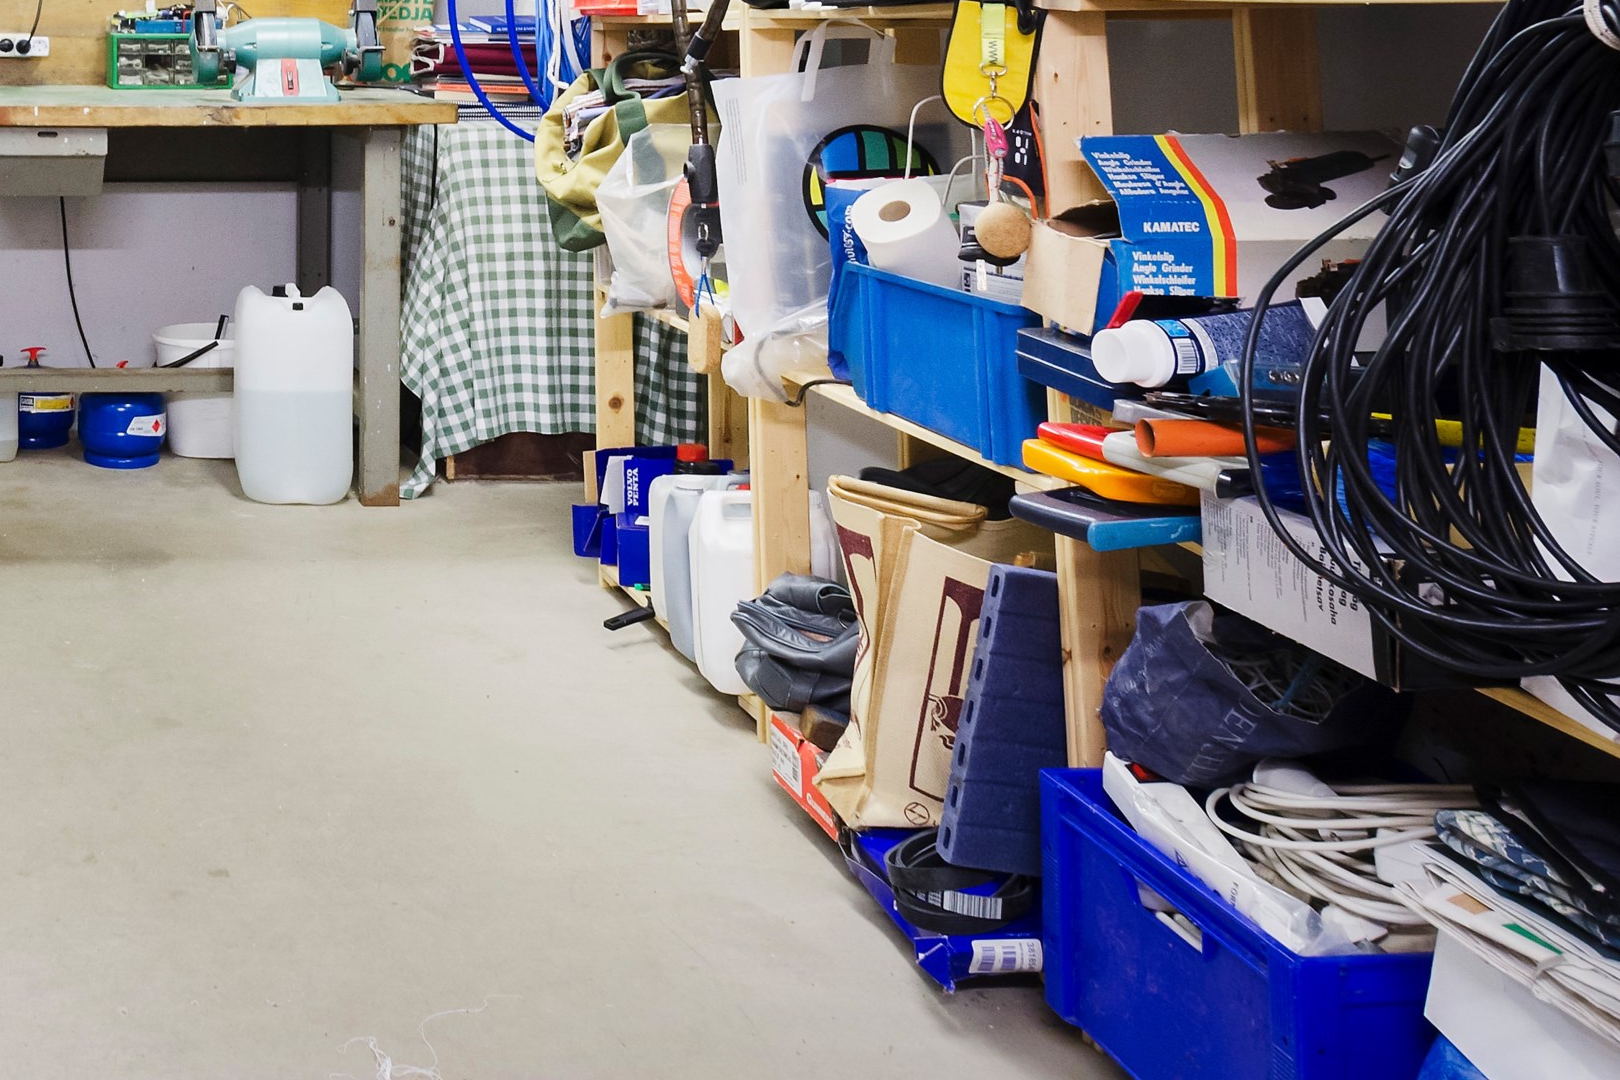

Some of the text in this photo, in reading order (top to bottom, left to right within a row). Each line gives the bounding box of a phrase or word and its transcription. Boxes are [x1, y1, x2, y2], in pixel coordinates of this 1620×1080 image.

[1142, 221, 1201, 233] KAMATEC
[1132, 251, 1175, 263] Vinkelslip
[1132, 263, 1194, 273] Angle Grinder
